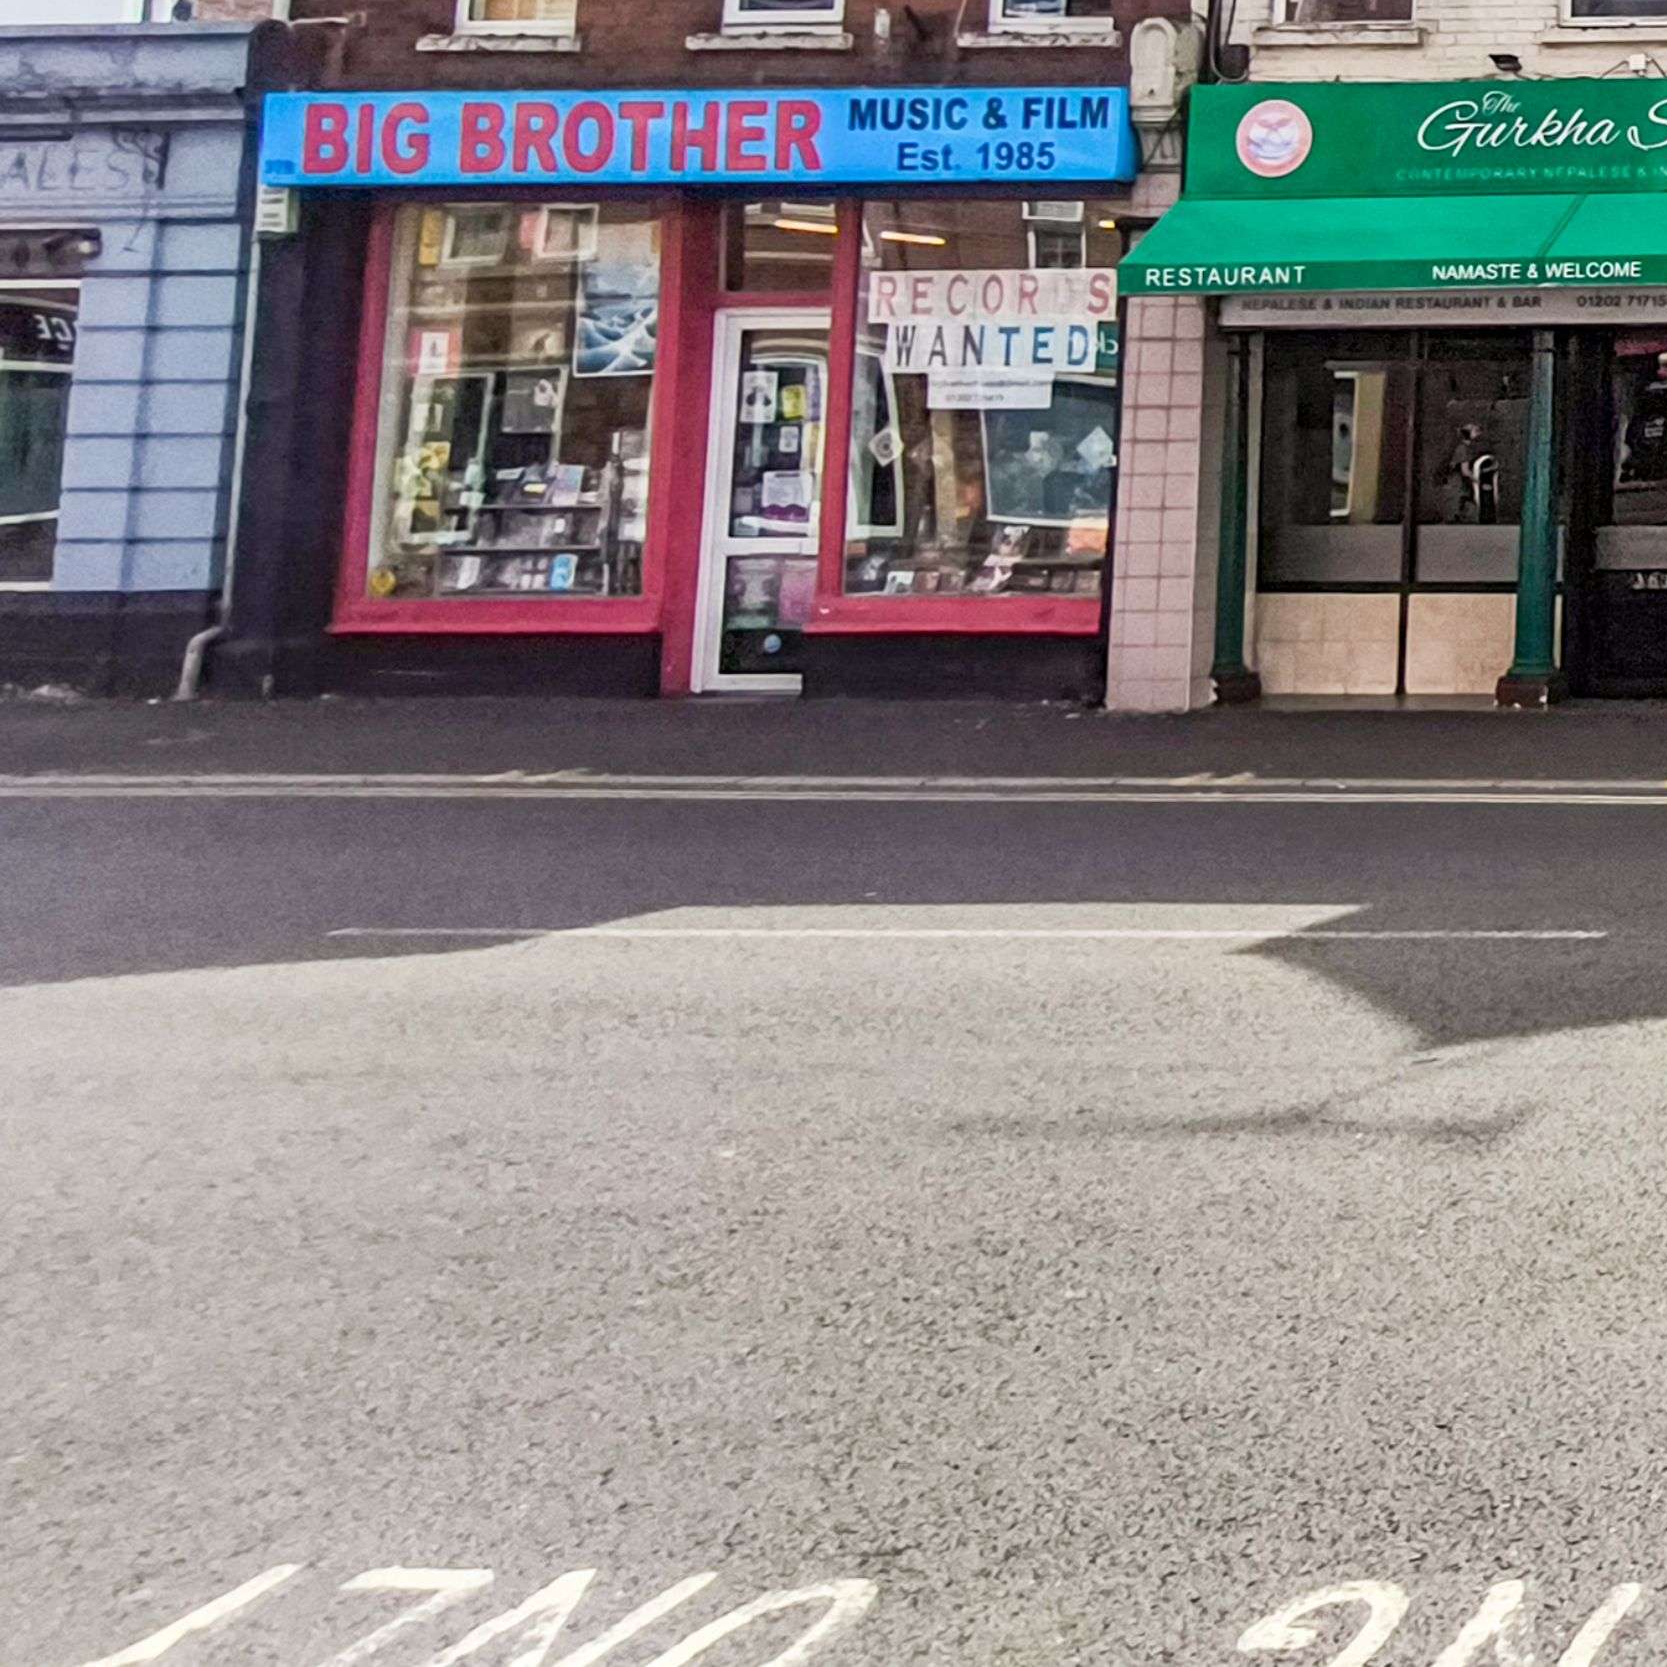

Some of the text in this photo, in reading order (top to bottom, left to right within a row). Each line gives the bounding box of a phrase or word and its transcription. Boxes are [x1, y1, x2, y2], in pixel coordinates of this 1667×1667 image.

[848, 97, 1110, 132] MUSIC & FILM
[1417, 100, 1620, 157] Gurkha
[303, 99, 823, 175] BIG BROTHER
[897, 141, 1056, 172] Est. 1985
[1397, 167, 1537, 181] CONTEMPORARY
[1543, 164, 1631, 179] NEPALESE
[1145, 266, 1306, 287] RESTAURANT
[1432, 261, 1642, 280] NAMASTE & WELCOME
[876, 272, 1111, 316] RECORS
[1242, 297, 1317, 311] NEPALESE
[1339, 297, 1390, 310] INDIAN
[1395, 295, 1489, 310] RESTAURANT
[1498, 295, 1506, 308] &
[1512, 295, 1542, 308] BAR
[1576, 294, 1621, 308] 01202
[895, 324, 1089, 367] WANTED
